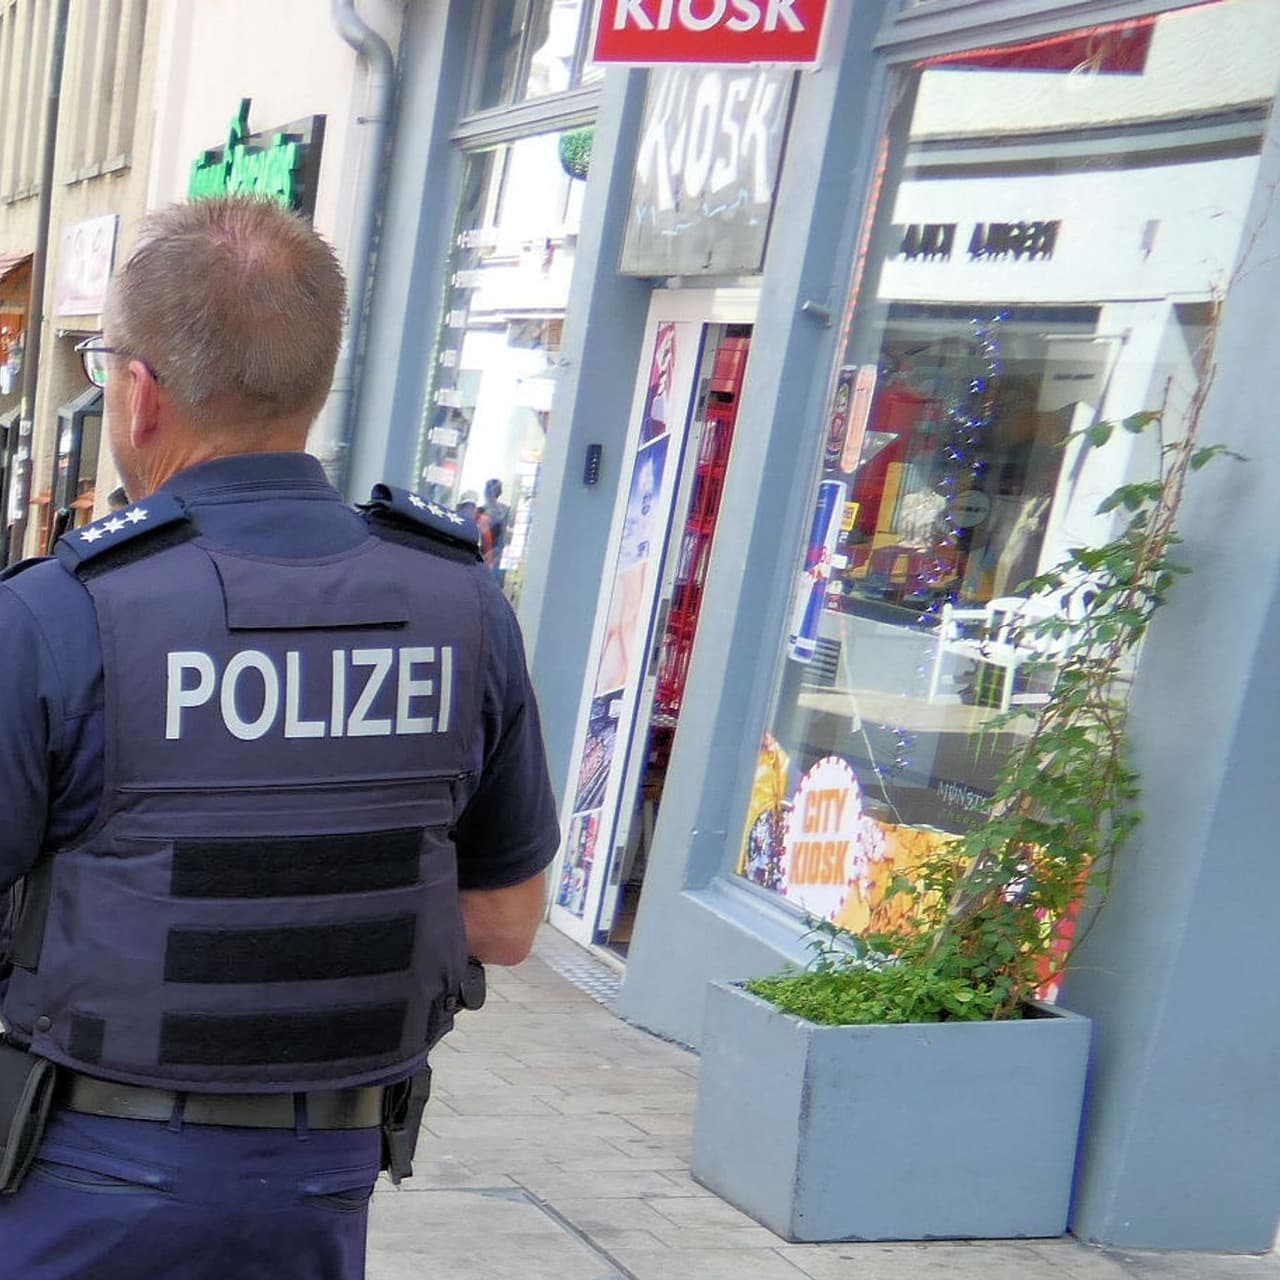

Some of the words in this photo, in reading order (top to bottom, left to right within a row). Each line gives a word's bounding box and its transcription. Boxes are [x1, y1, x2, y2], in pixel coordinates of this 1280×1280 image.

[613, 0, 805, 32] KIOSK
[637, 69, 777, 211] KIOSK
[165, 646, 453, 741] POLIZEI
[803, 788, 849, 834] CITY
[789, 840, 850, 886] KIOSK
